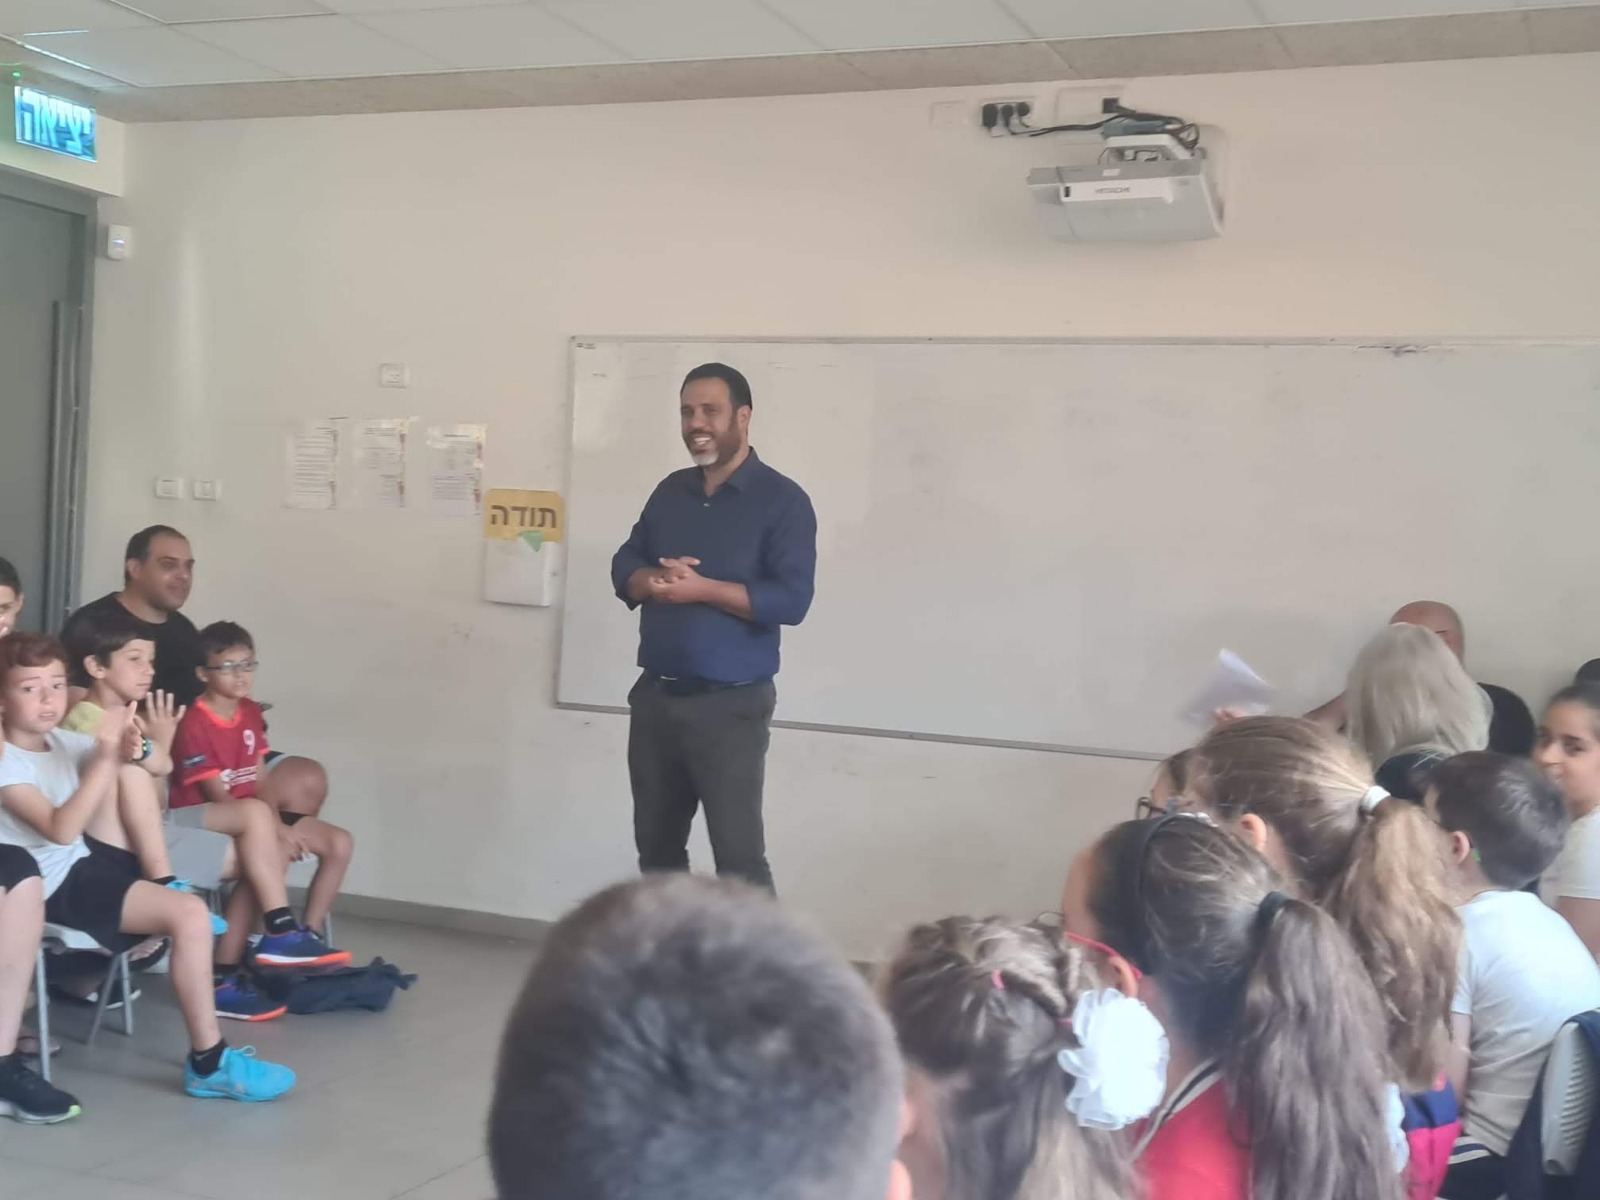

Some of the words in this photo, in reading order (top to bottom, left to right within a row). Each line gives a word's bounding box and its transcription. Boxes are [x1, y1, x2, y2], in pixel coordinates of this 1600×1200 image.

[21, 88, 92, 154] יציאה
[491, 505, 556, 528] תודה
[242, 729, 256, 755] 9
